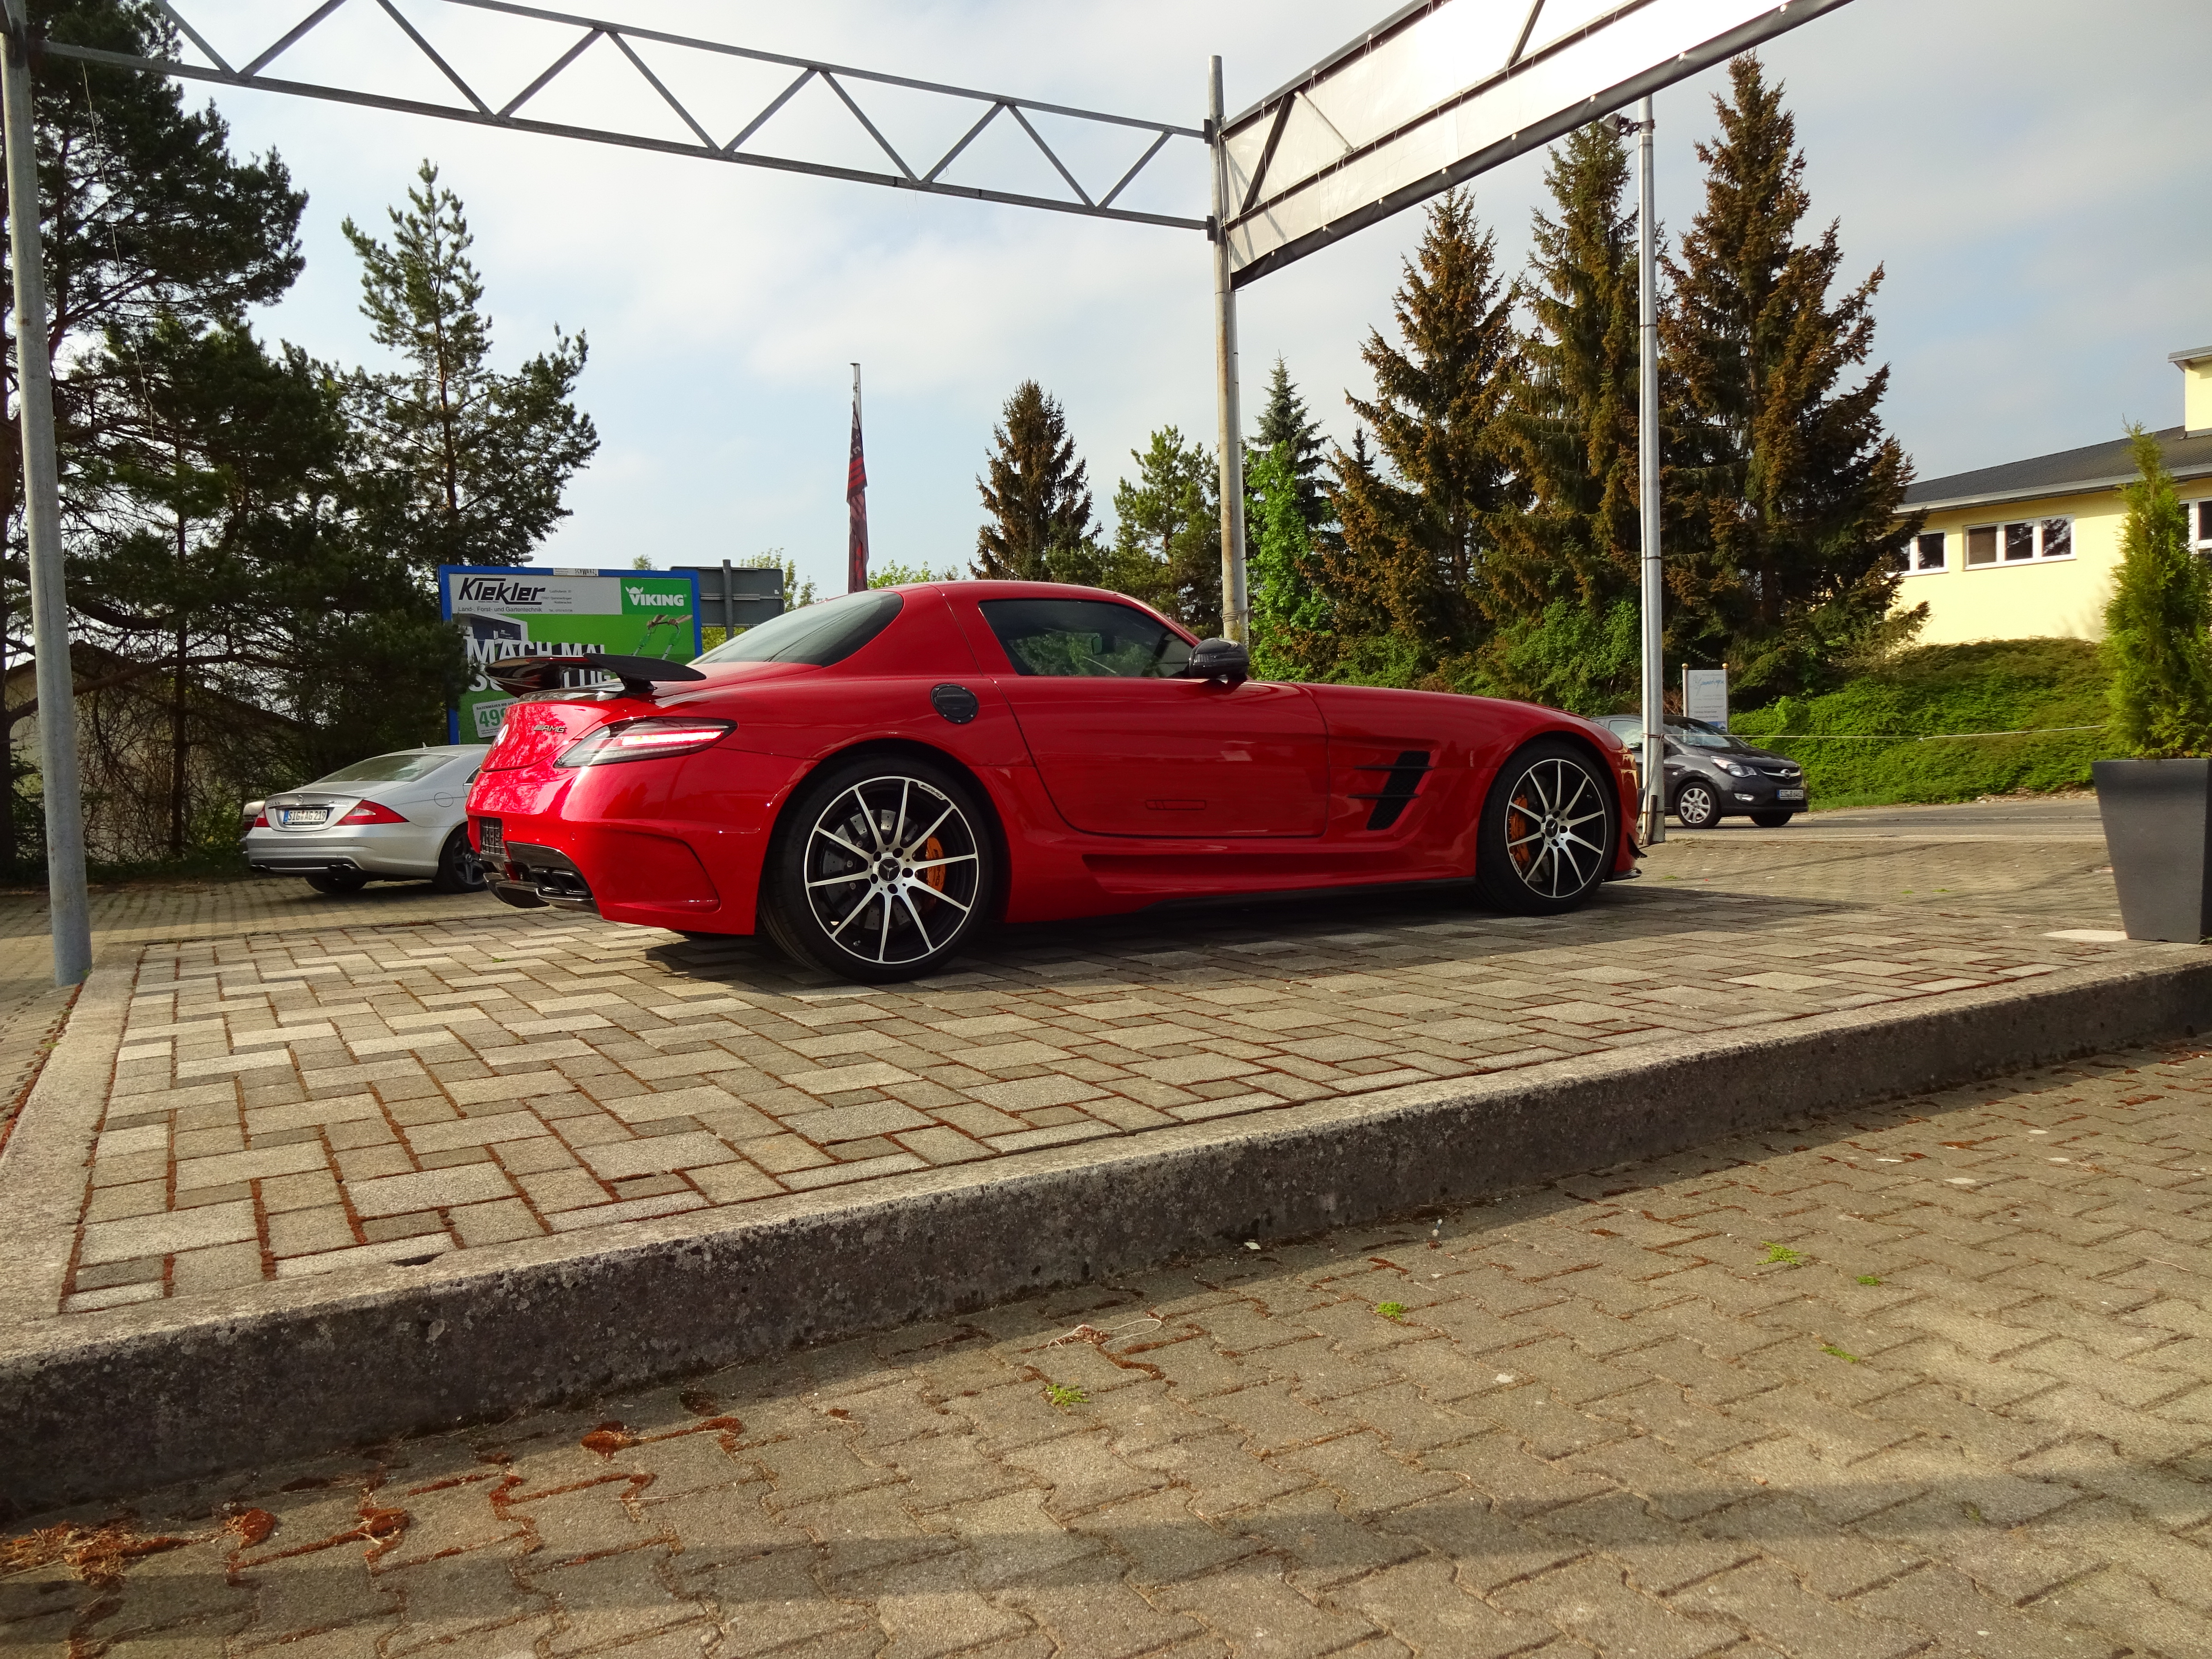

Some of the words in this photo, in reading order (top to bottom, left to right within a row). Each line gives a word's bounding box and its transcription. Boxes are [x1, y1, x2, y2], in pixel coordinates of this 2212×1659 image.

[628, 594, 684, 606] VIKING
[288, 811, 300, 820] SIG
[305, 811, 313, 821] AG
[314, 810, 326, 820] 219
